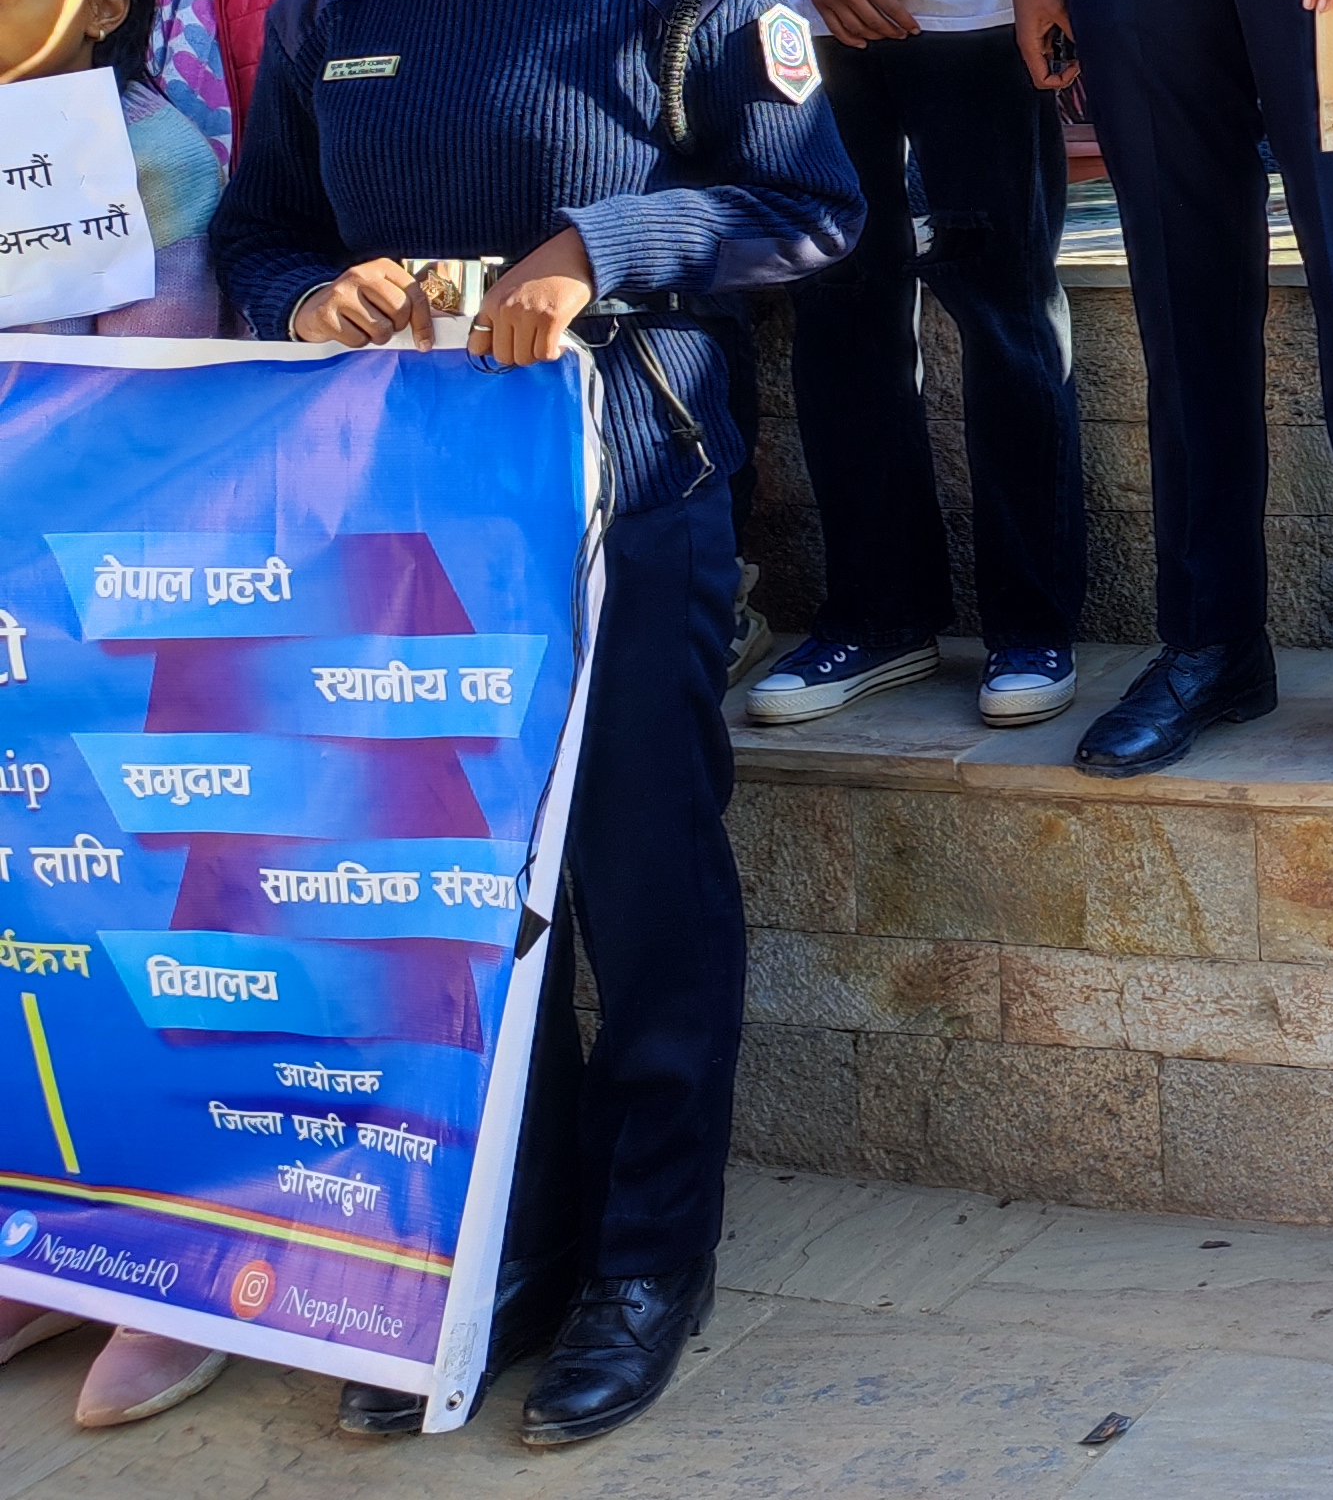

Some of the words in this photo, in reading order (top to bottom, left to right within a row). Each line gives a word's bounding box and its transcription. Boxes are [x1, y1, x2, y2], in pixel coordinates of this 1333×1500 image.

[0, 222, 72, 255] अन्त्य
[79, 203, 132, 241] गरौं
[93, 554, 195, 603] नेपाल
[203, 556, 294, 606] प्रहरी
[310, 659, 449, 704] स्थानीय
[457, 667, 514, 704] तह
[0, 749, 51, 810] ip
[121, 763, 252, 807] समुदाय
[28, 833, 125, 888] लागि
[258, 860, 421, 905] सामाजिक
[430, 865, 516, 911] संस्था
[0, 928, 93, 980] र्यक्रम
[146, 954, 279, 1003] विद्यालय
[272, 1061, 385, 1095] आयोजक
[208, 1100, 284, 1135] जिल्ला
[291, 1112, 347, 1149] प्रहरी
[356, 1122, 438, 1167] कार्यालय
[26, 1231, 180, 1299] /NepalPoliceHQ
[276, 1283, 404, 1340] /Nepalpolice
